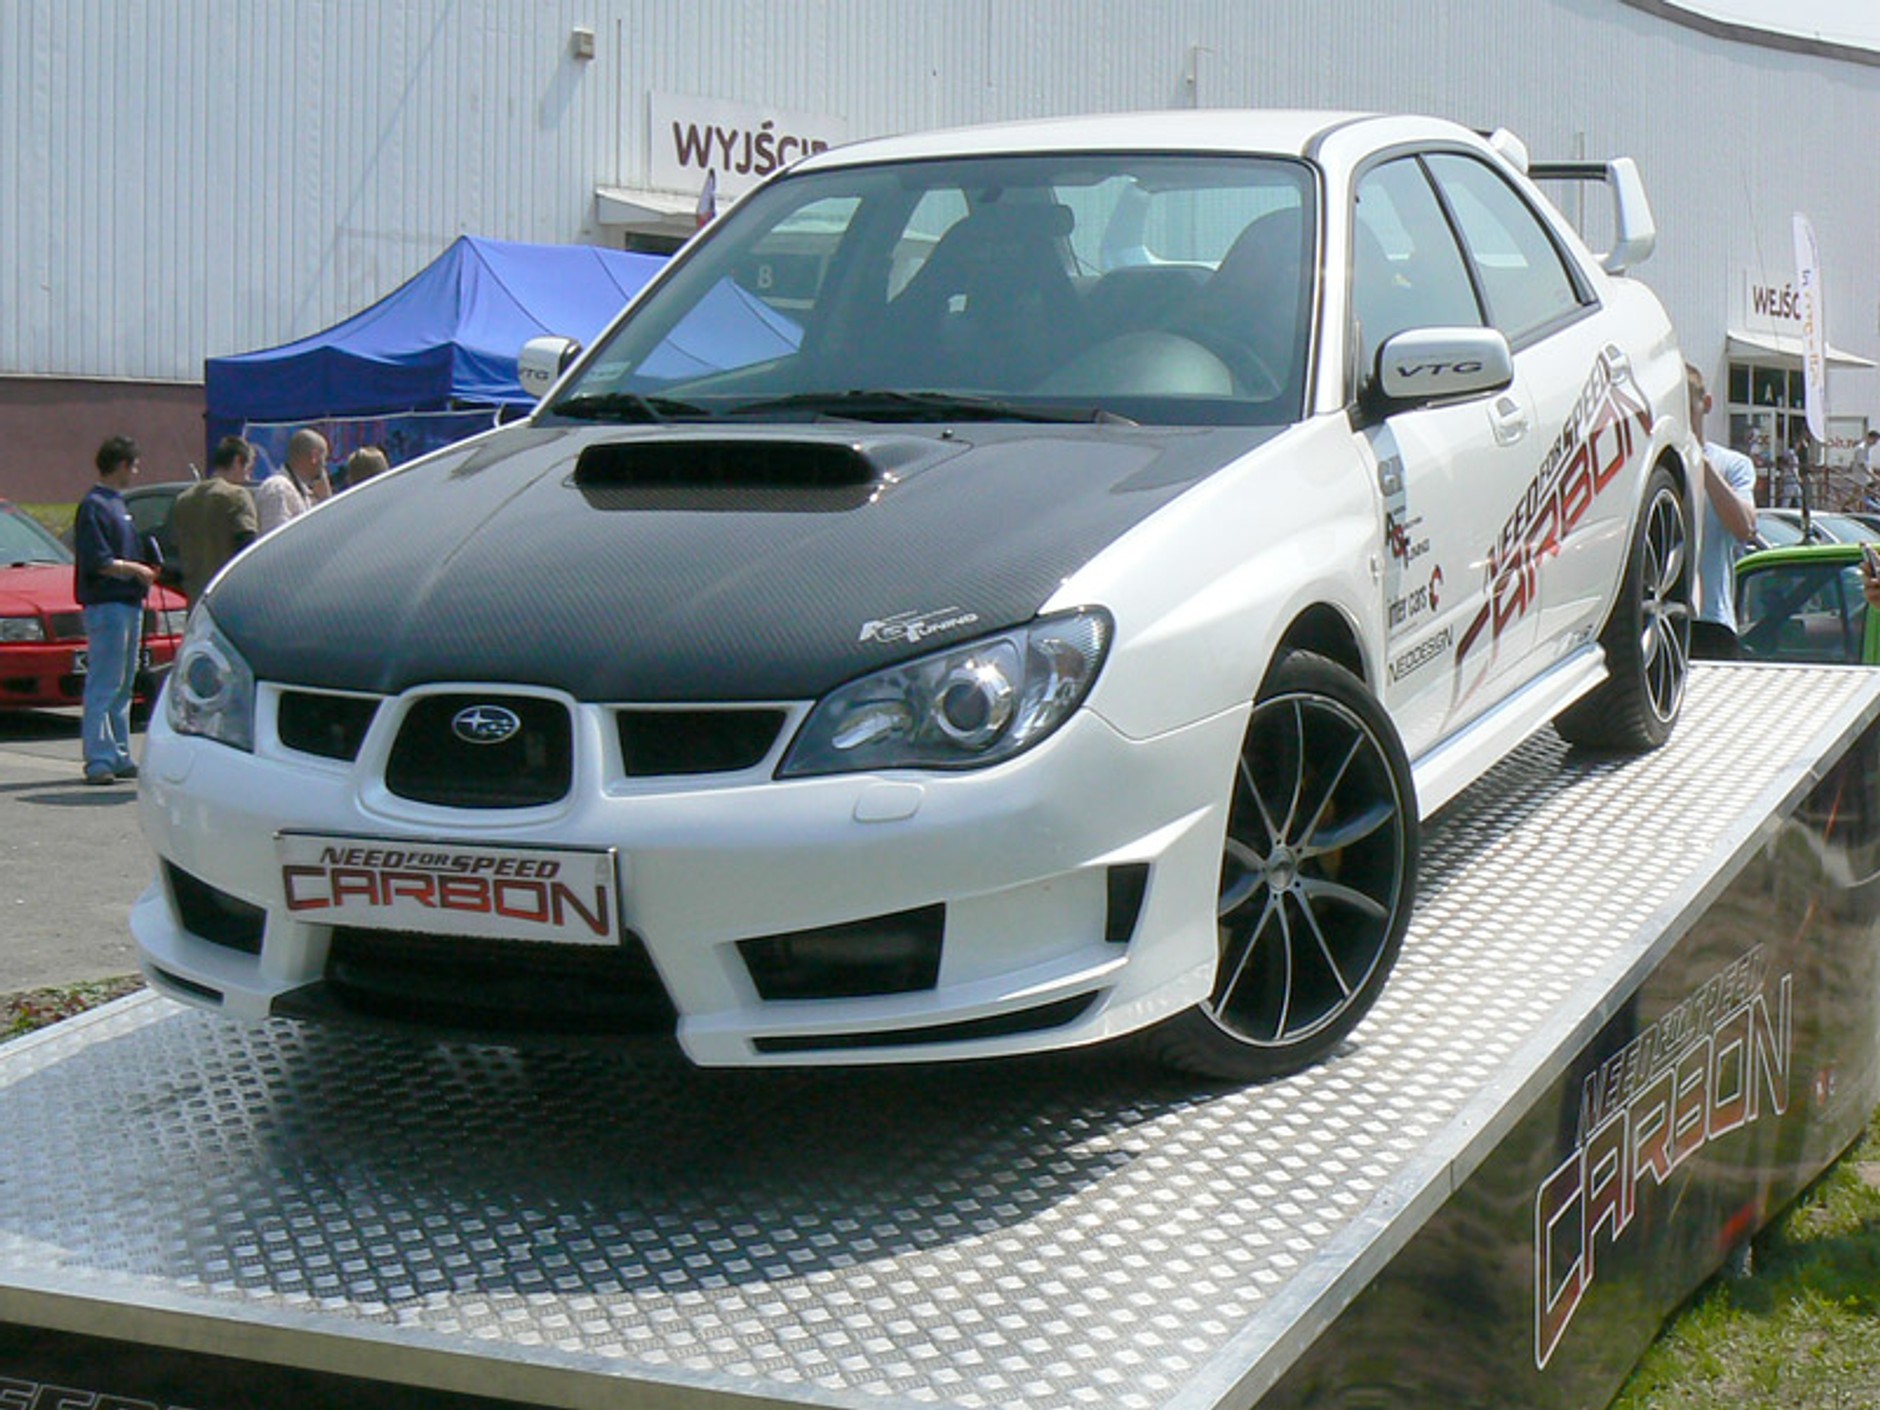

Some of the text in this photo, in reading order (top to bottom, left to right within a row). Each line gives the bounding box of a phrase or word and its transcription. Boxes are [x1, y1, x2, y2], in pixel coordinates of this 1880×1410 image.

[672, 120, 828, 177] WYJŚC
[1752, 284, 1802, 320] WEJŚC
[520, 368, 549, 380] TG
[1396, 361, 1483, 378] VTG
[320, 847, 560, 878] NEED FOR SPEED
[283, 865, 609, 936] CARBON
[1535, 972, 1793, 1370] CARBON
